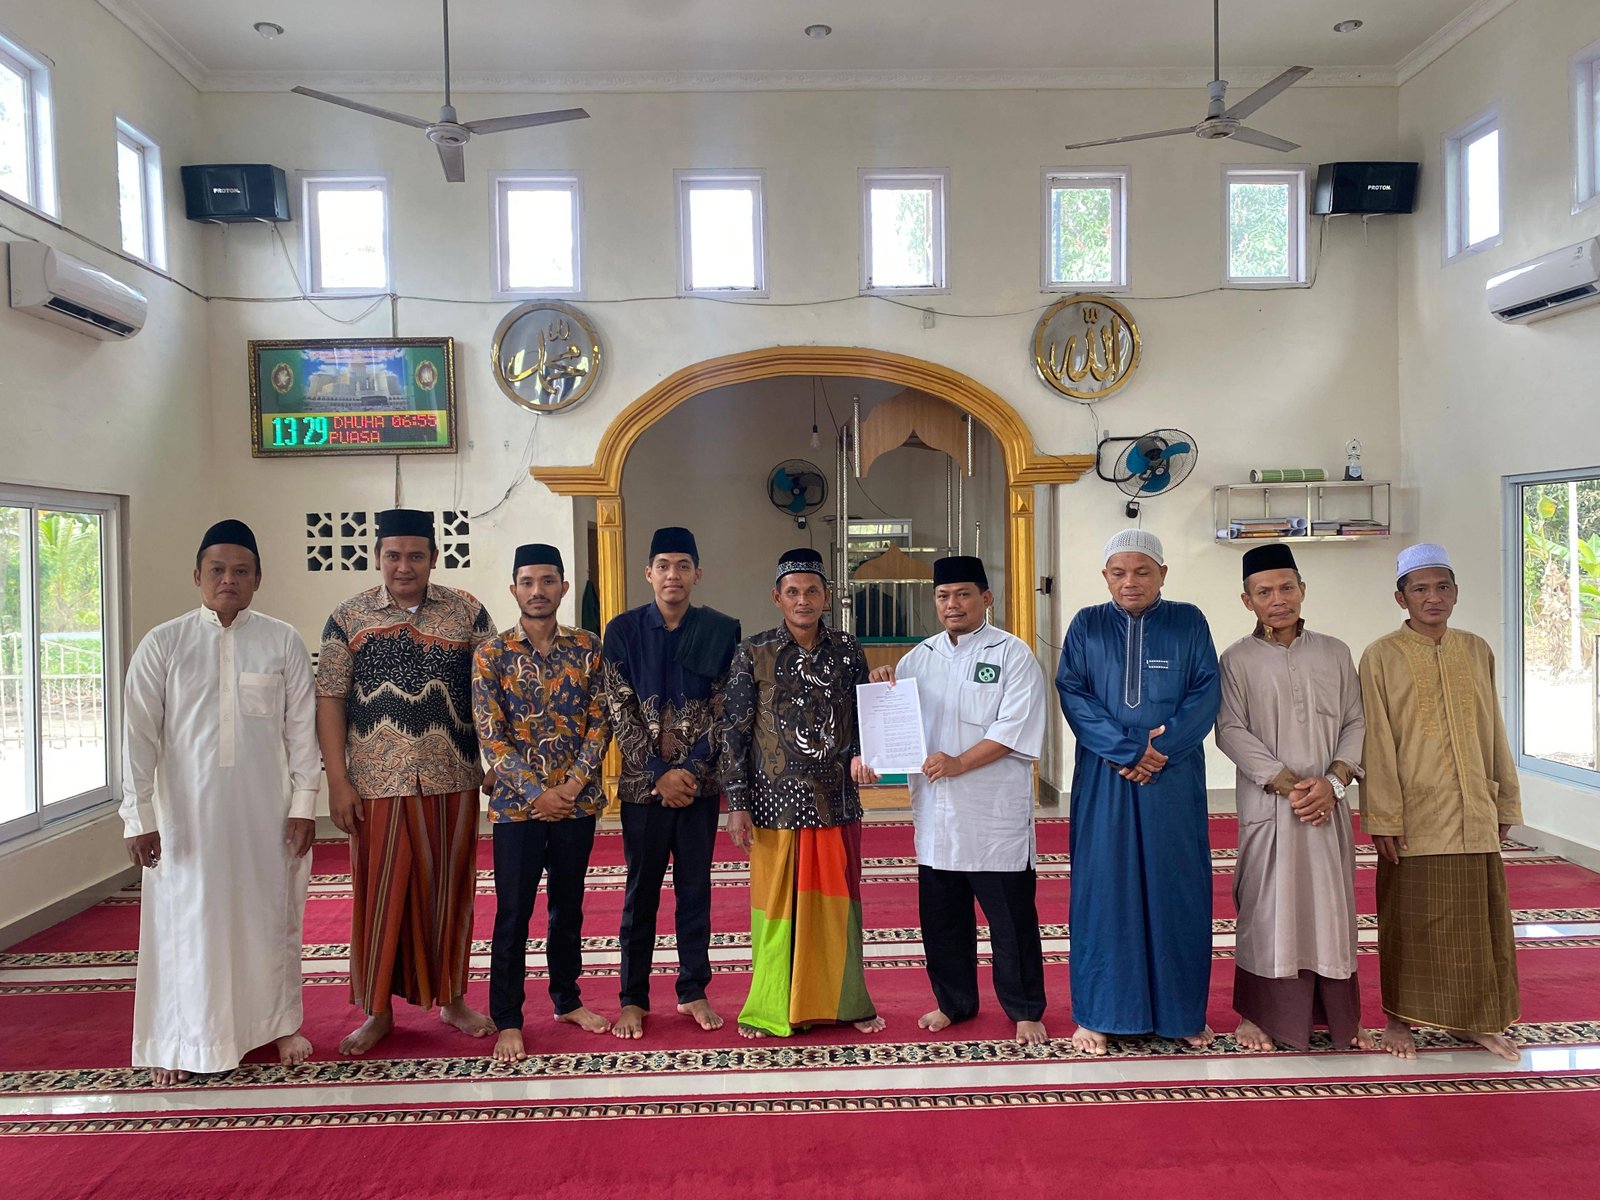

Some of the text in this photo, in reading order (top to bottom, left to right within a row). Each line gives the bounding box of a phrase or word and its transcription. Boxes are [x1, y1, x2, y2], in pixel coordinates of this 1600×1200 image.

[333, 414, 437, 428] DHUHA 06:55
[329, 431, 380, 444] PUASA
